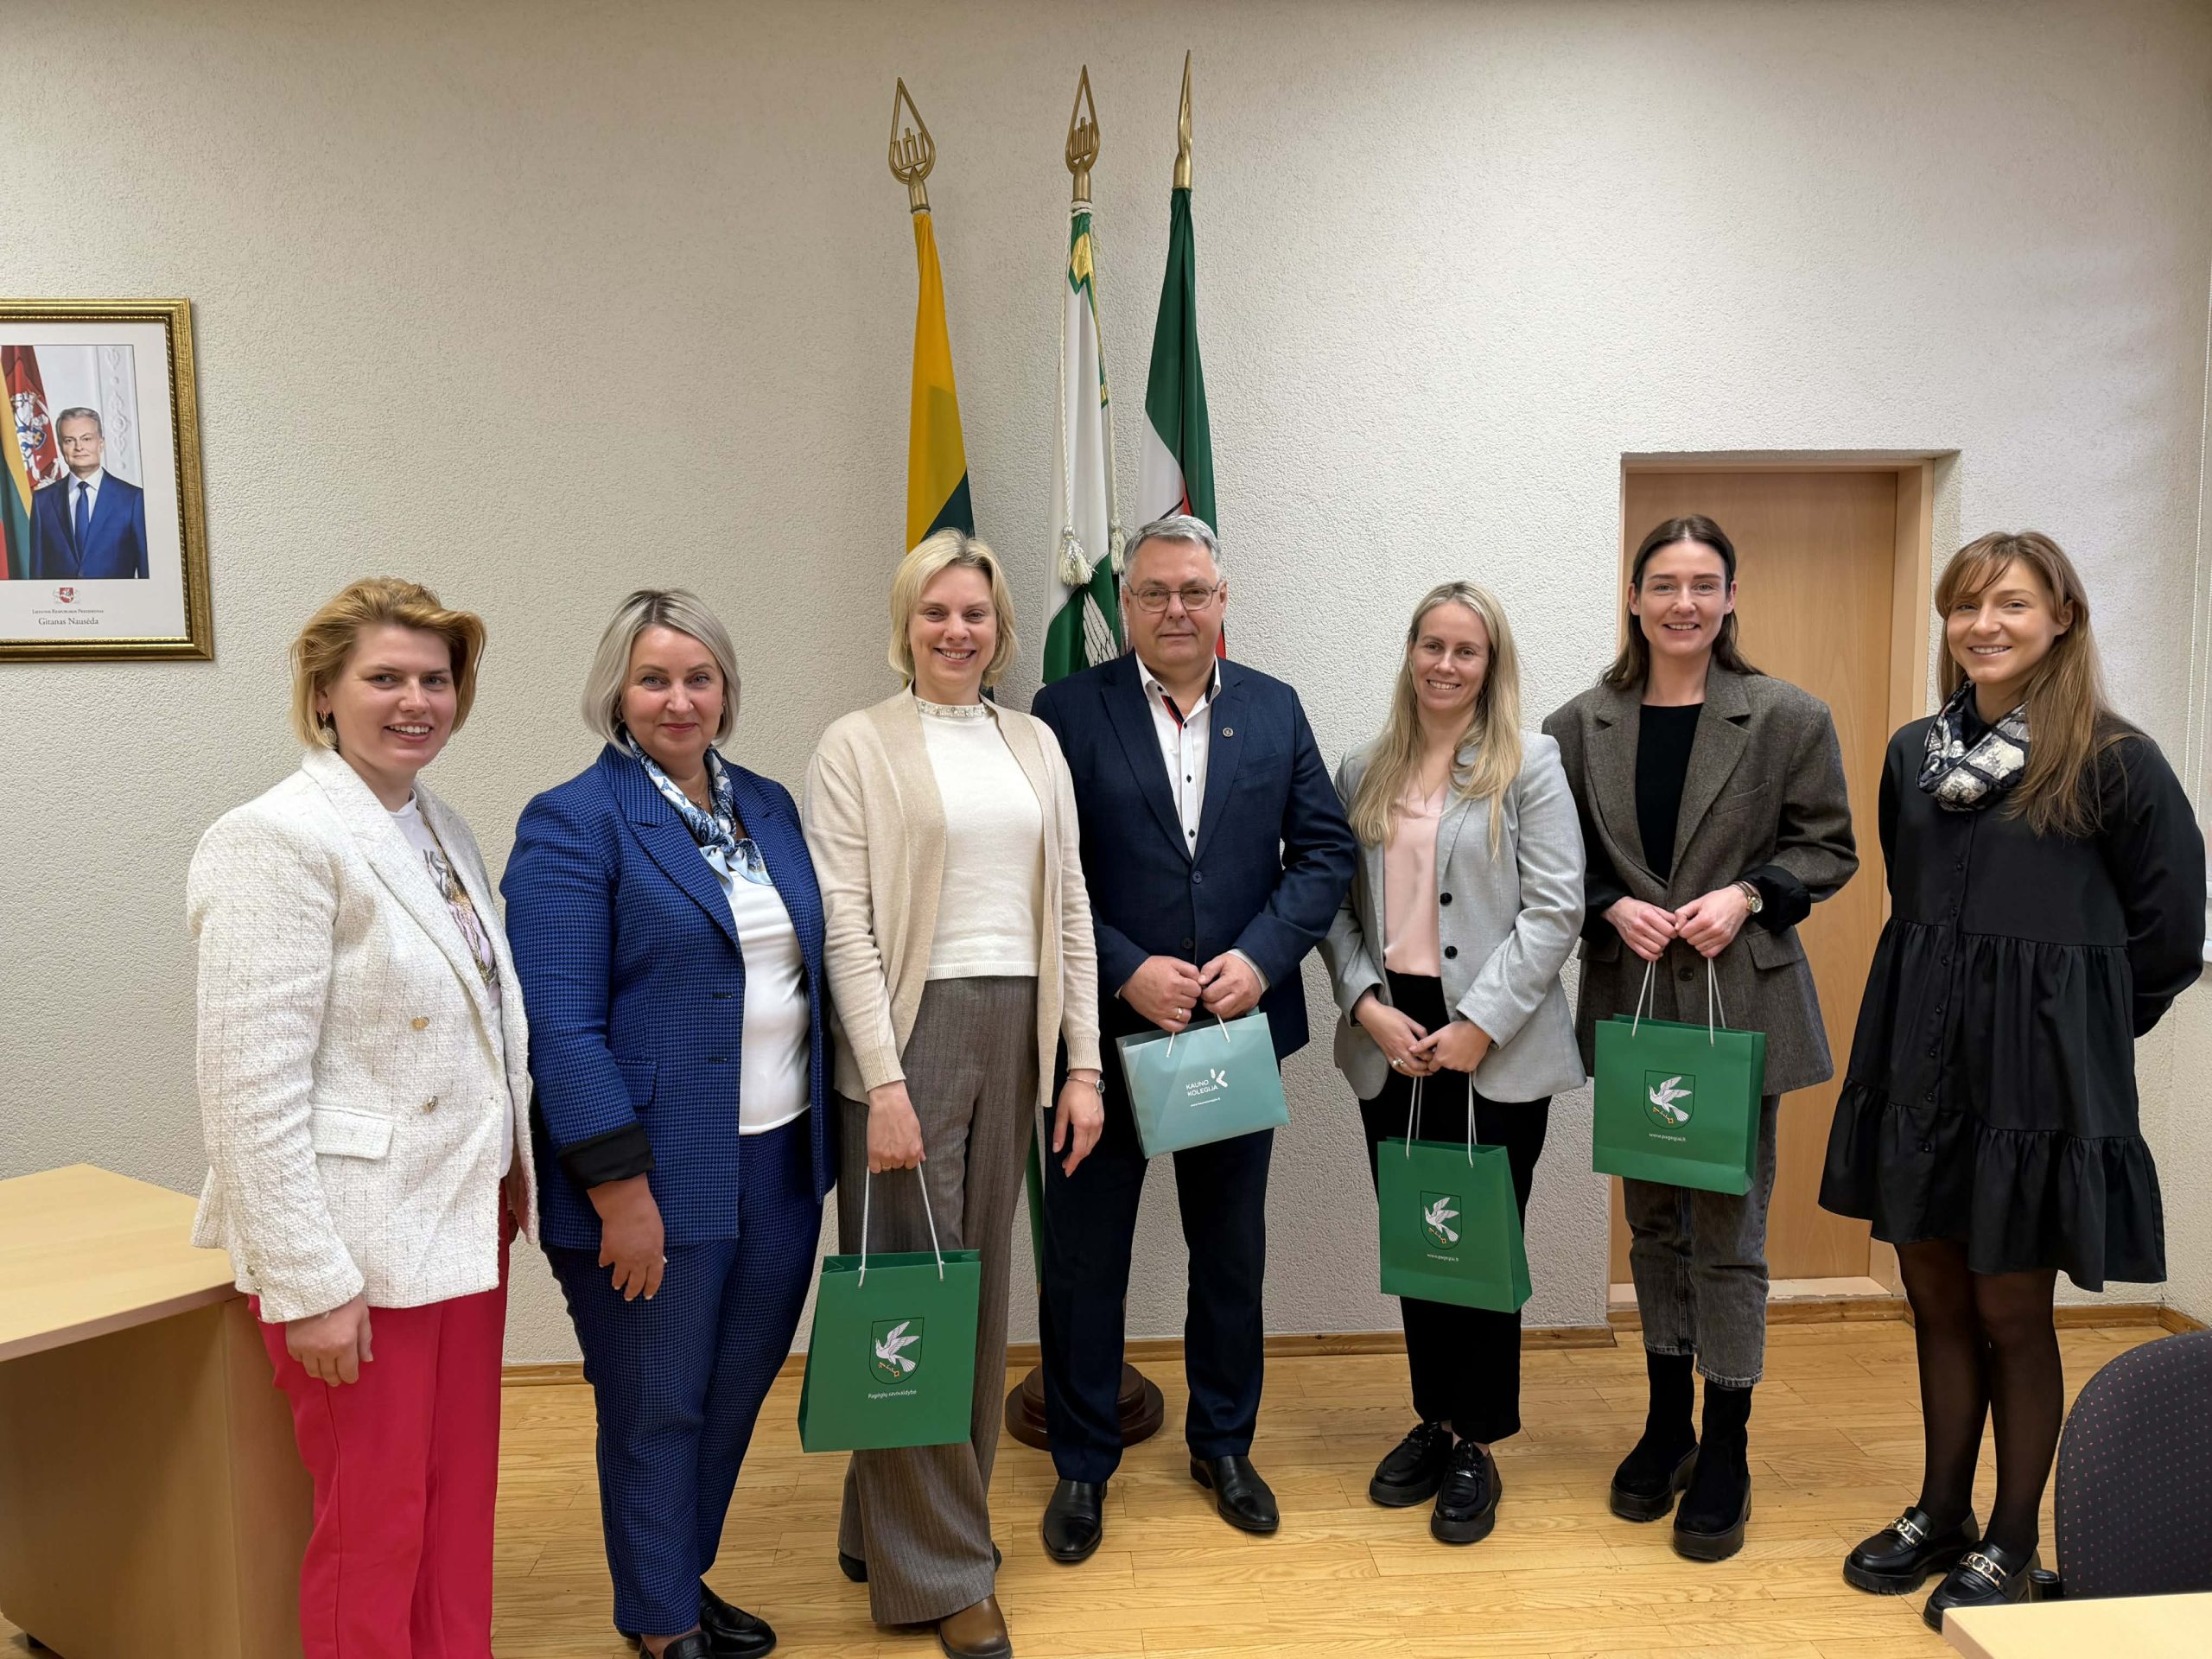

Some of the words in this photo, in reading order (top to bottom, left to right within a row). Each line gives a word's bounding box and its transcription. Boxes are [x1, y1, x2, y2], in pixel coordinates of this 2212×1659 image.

[38, 617, 67, 626] Gitanas
[68, 617, 99, 626] Nausėda
[1185, 1079, 1210, 1090] KAUNO
[1187, 1084, 1218, 1096] KOLEGIJA
